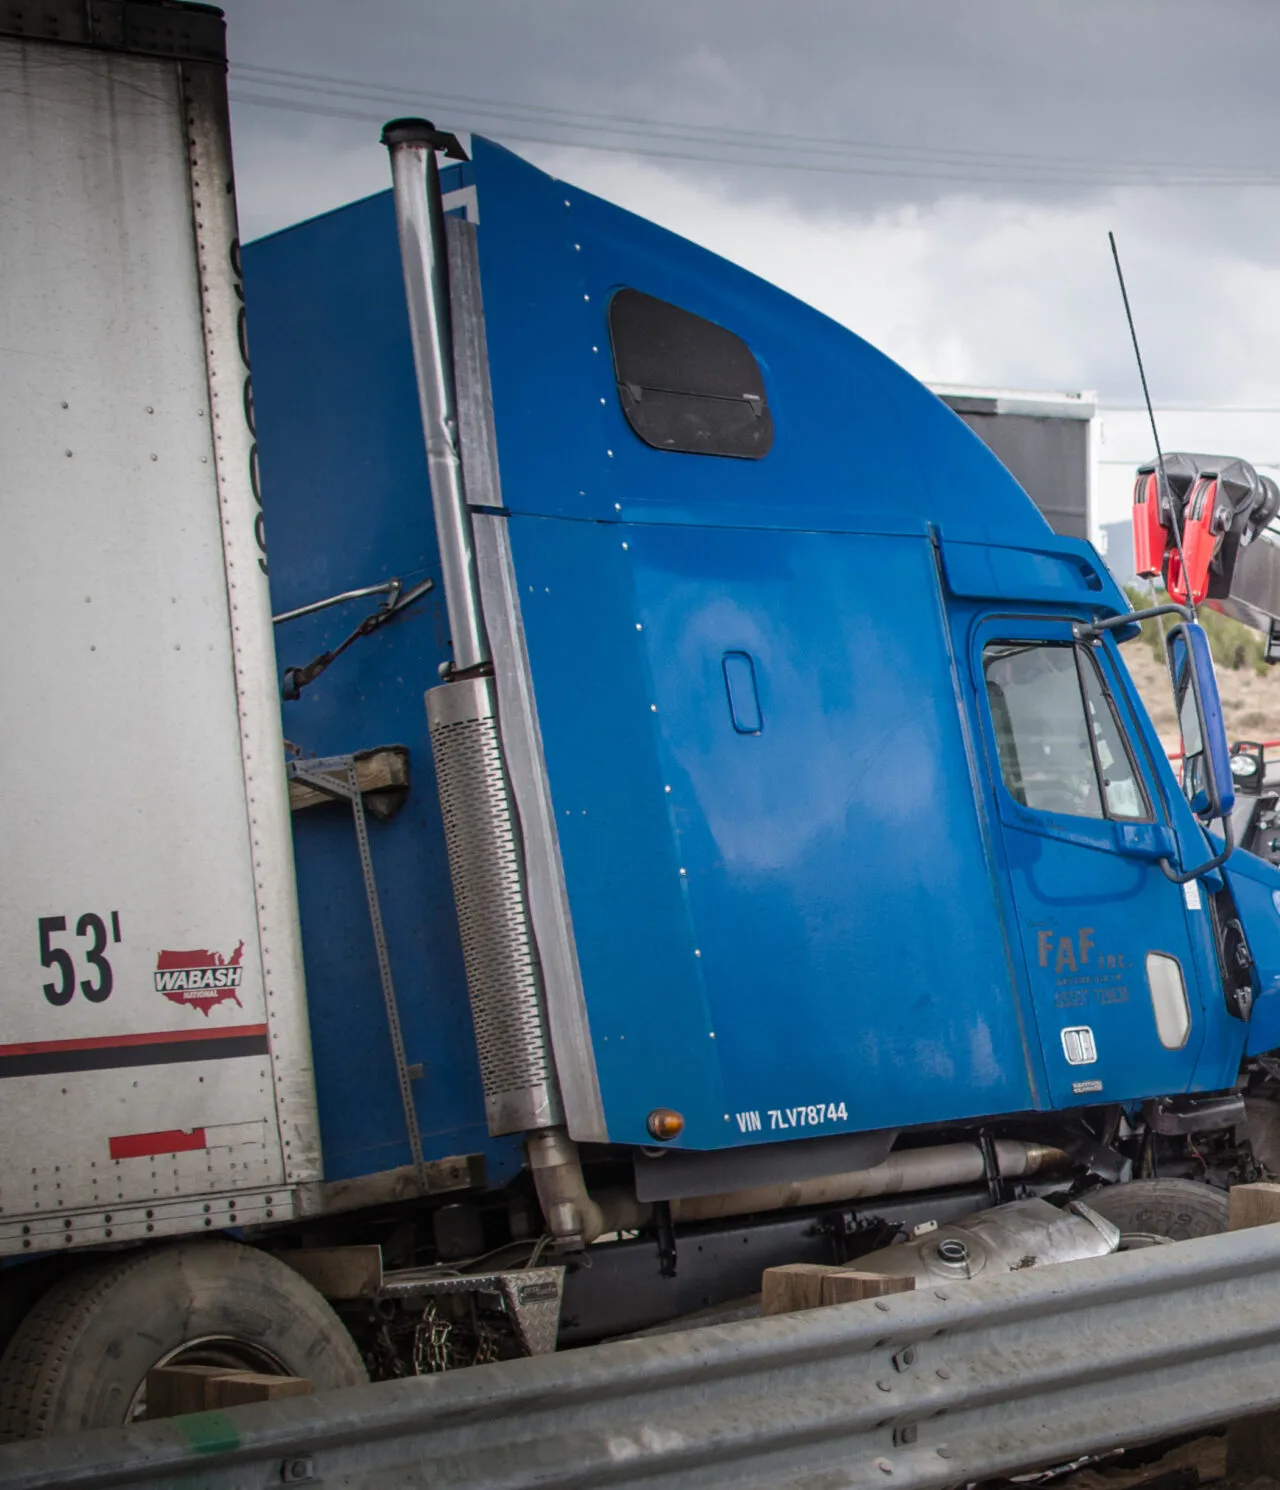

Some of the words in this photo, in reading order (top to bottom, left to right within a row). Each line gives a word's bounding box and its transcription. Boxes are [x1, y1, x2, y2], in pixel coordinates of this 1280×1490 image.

[38, 910, 122, 1006] 53'
[1037, 927, 1095, 973] FAF
[155, 967, 242, 991] WABASH
[183, 989, 219, 999] NATIONAL
[735, 1111, 762, 1133] VIN
[767, 1102, 849, 1130] 7LV78744
